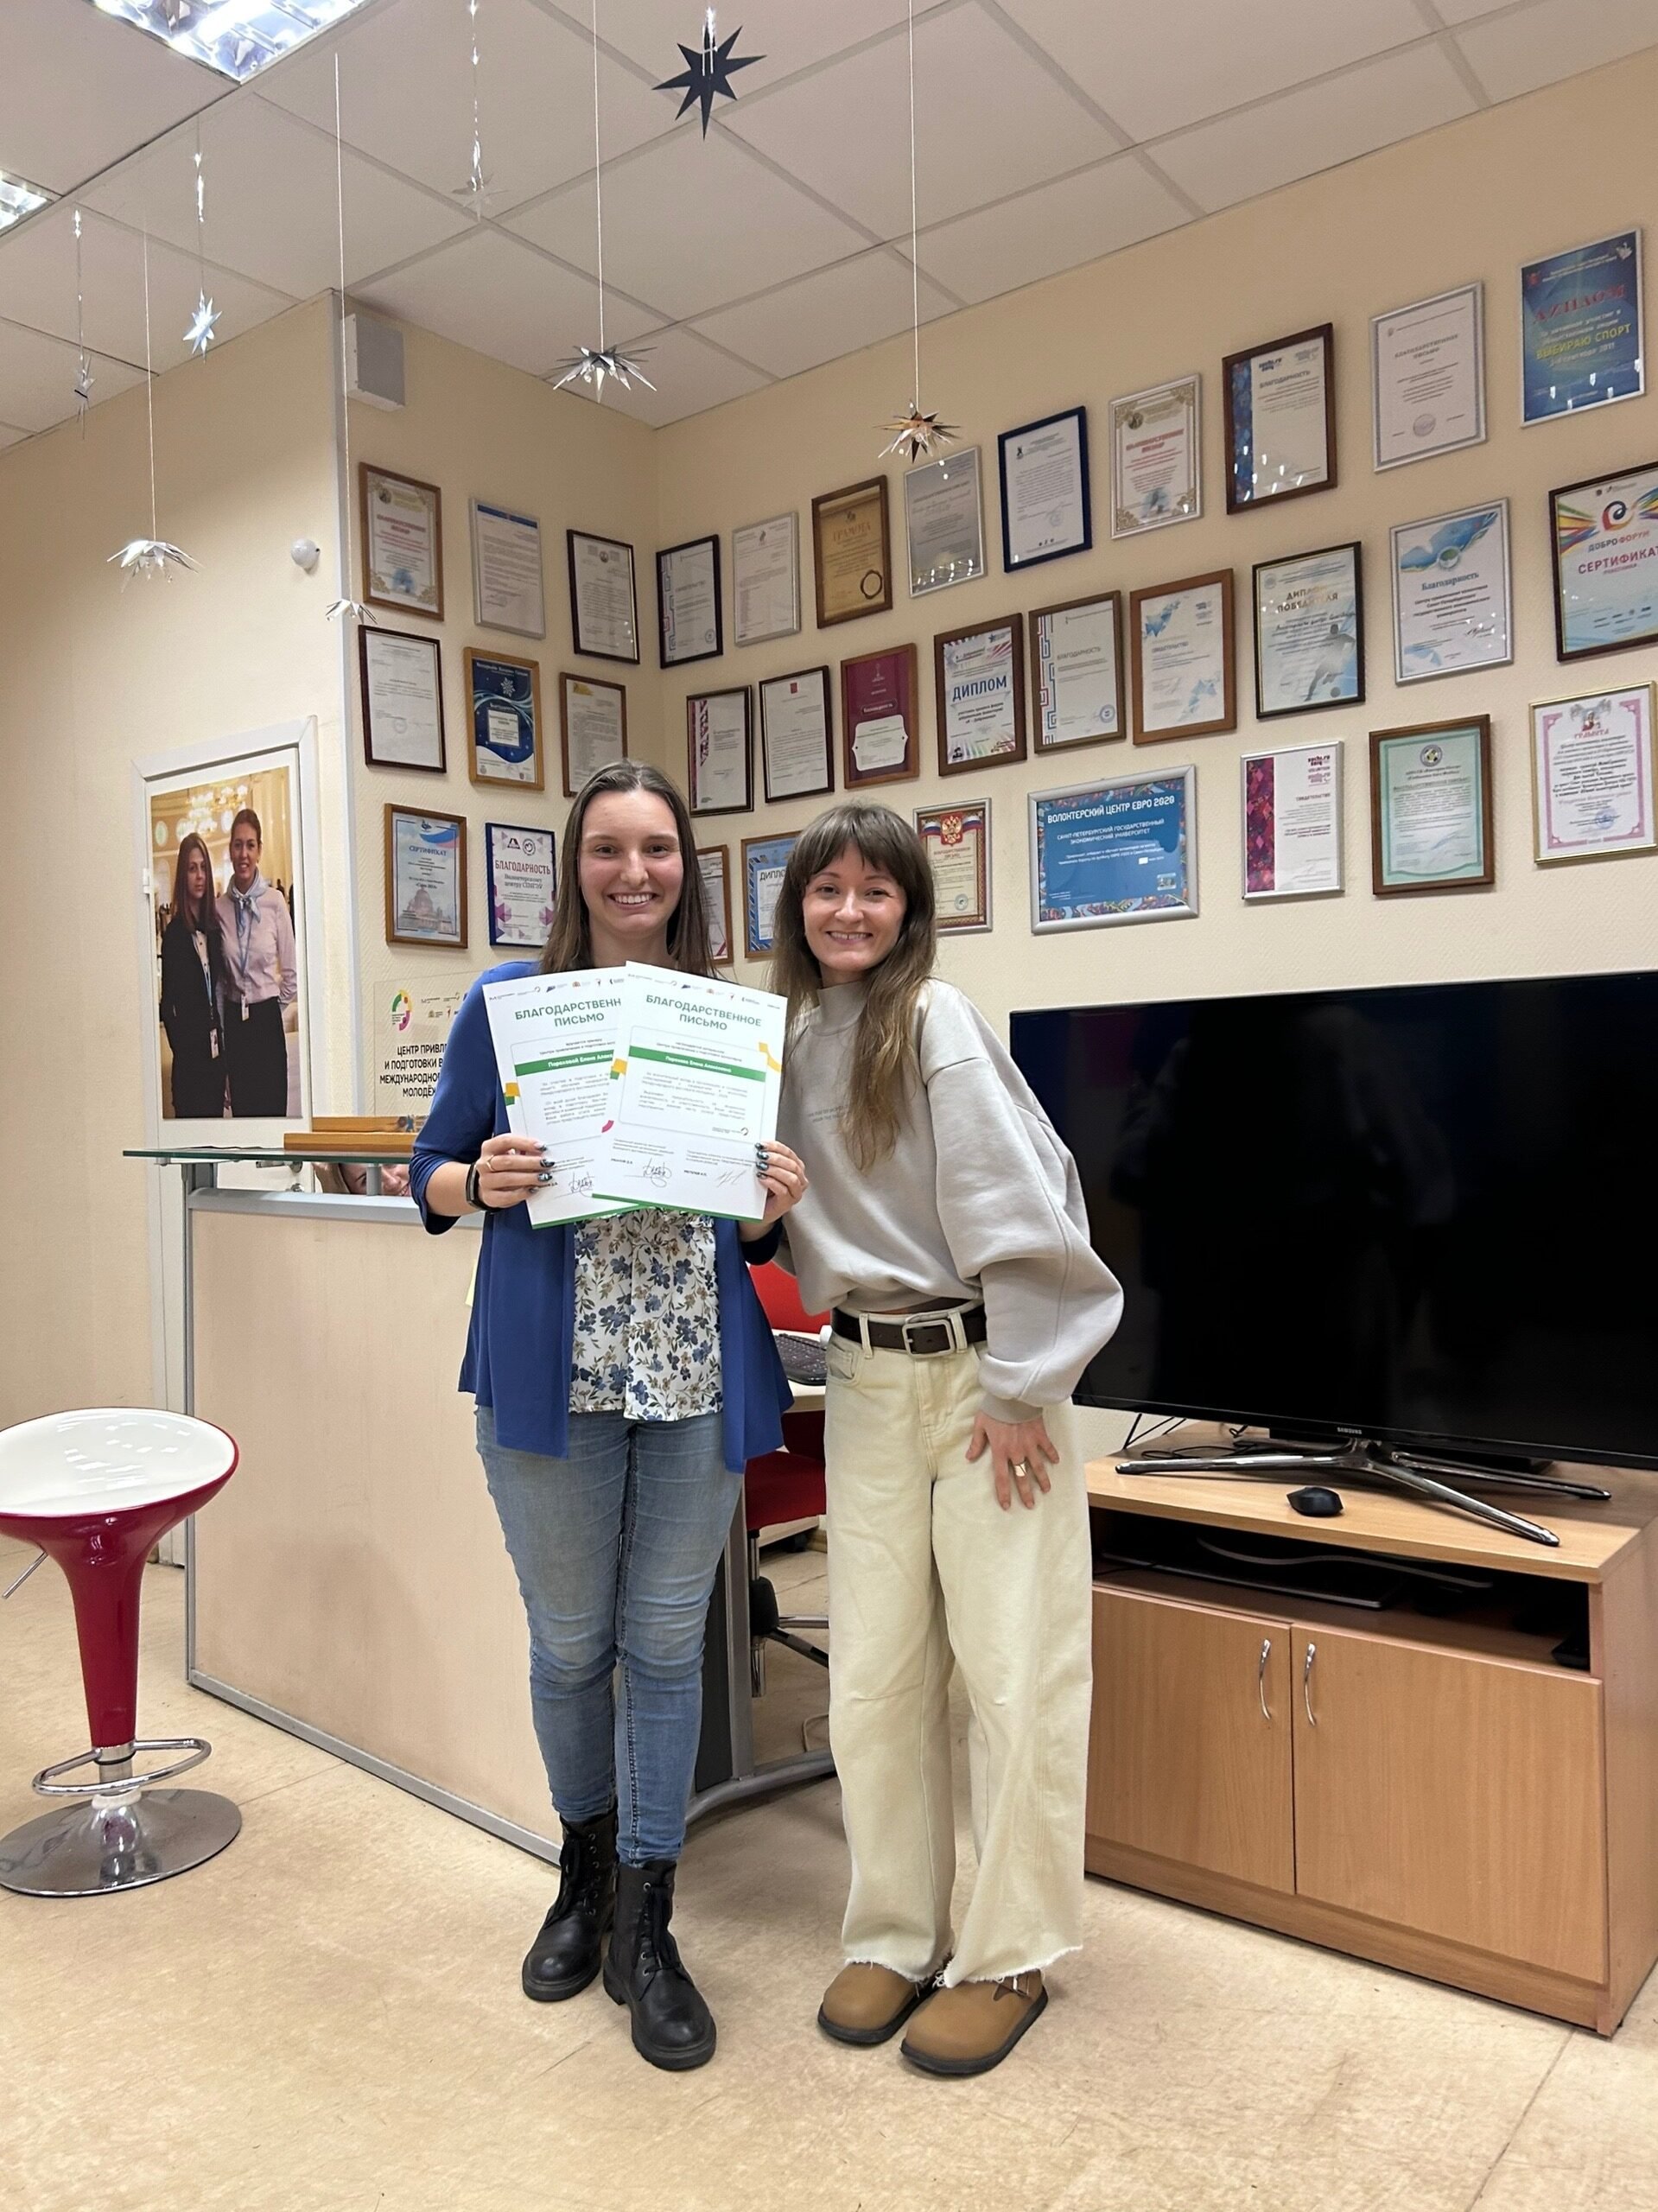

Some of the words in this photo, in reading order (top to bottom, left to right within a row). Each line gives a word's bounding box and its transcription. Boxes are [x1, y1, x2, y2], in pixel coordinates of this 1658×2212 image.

[1595, 323, 1631, 343] СПОРТ
[1421, 572, 1479, 591] Благодарность
[952, 675, 1007, 702] ДИПЛОМ
[1047, 804, 1104, 824] ВОЛОНТЕРСКИЙ
[1105, 802, 1130, 816] ЦЕНТР
[1132, 798, 1152, 810] ЕВРО
[1153, 795, 1175, 807] 2020
[1115, 828, 1151, 839] УНИВЕРСИТЕТ
[495, 860, 551, 875] БЛАГОДАРНОСТЬ
[514, 997, 622, 1020] БЛАГОДАРСТВЕНН
[645, 995, 762, 1027] БЛАГОДАРСТВЕННОЕ
[554, 1012, 605, 1027] ПИСЬМО
[679, 1014, 727, 1031] ПИСЬМО
[397, 1045, 419, 1056] ЦЕНТР
[384, 1060, 390, 1070] И
[391, 1058, 437, 1070] ПОДГОТОВКИ
